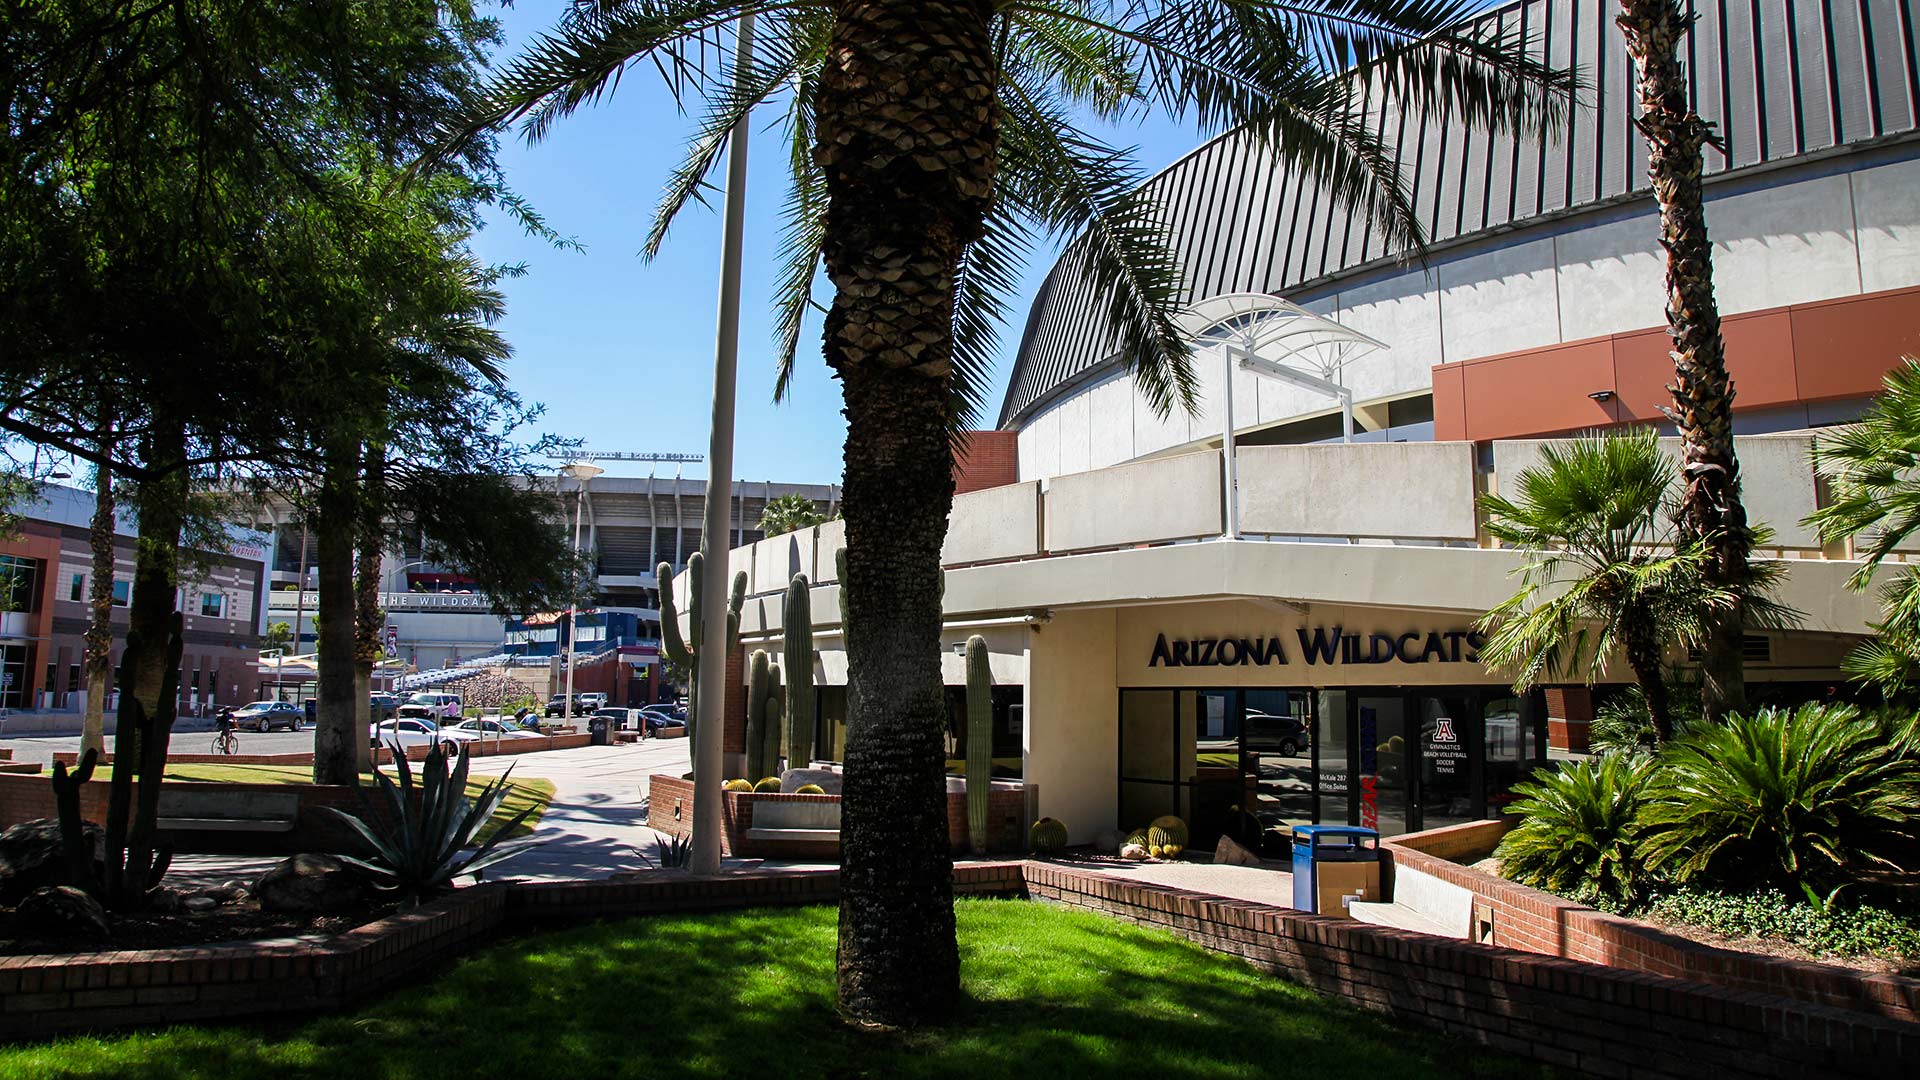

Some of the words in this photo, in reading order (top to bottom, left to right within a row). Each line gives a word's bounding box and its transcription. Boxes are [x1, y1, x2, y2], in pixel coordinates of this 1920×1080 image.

[382, 596, 408, 605] THE
[420, 597, 489, 607] WILDCAT
[1148, 632, 1289, 667] ARIZONA
[1295, 625, 1487, 666] WILDCATS
[1432, 718, 1457, 742] A
[1439, 751, 1467, 759] VOLLEYBALL
